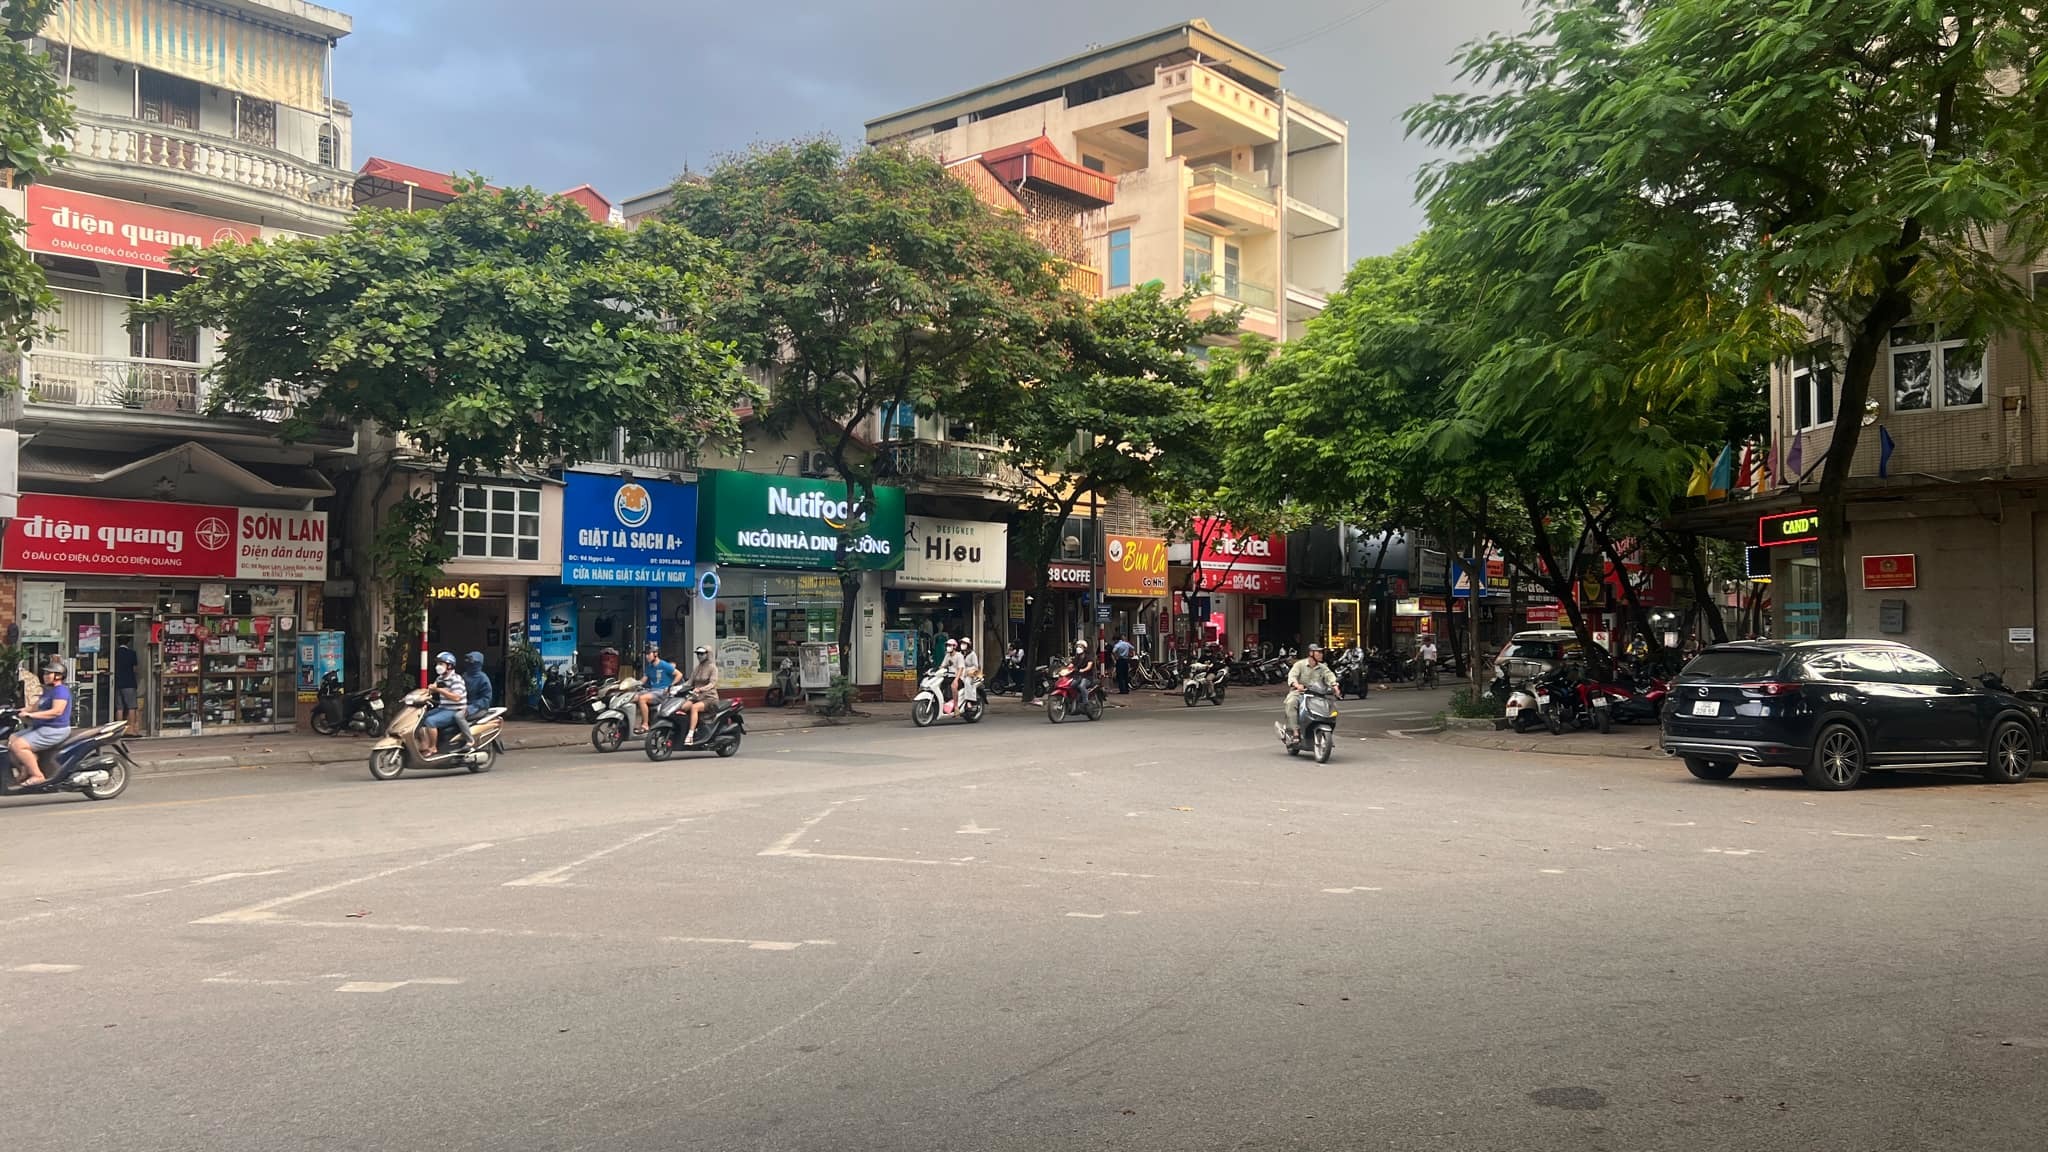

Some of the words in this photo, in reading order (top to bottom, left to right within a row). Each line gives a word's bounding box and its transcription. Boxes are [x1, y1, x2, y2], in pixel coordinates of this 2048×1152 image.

[41, 206, 114, 236] điện
[13, 515, 90, 542] điện
[98, 526, 184, 553] quang
[242, 512, 282, 540] SƠN
[288, 518, 324, 542] LAN
[936, 525, 976, 536] DESIGNER
[1782, 518, 1808, 534] CAND
[579, 528, 609, 550] GIẶT
[612, 529, 627, 548] LÀ
[630, 532, 664, 551] SẠCH
[666, 534, 682, 550] A+
[738, 529, 775, 548] NGÔI
[777, 531, 809, 550] NHÀ
[32, 551, 52, 561] ĐÂU
[53, 552, 66, 562] CÓ
[100, 554, 115, 564] ĐÓ
[116, 555, 128, 564] CÓ
[130, 556, 150, 566] ĐIỆN
[152, 558, 182, 567] QUANG
[242, 544, 268, 560] Điện
[271, 545, 292, 558] dân
[296, 547, 324, 562] dụng
[1122, 540, 1150, 572] Bún
[573, 565, 590, 580] CỬA
[592, 567, 614, 580] HÀNG
[616, 568, 633, 582] GIẶT
[635, 566, 650, 581] SẤY
[652, 568, 666, 582] LẤY
[668, 571, 687, 582] NGAY
[1061, 569, 1091, 582] COFFE
[1244, 574, 1260, 590] 4G
[458, 582, 480, 599] 96
